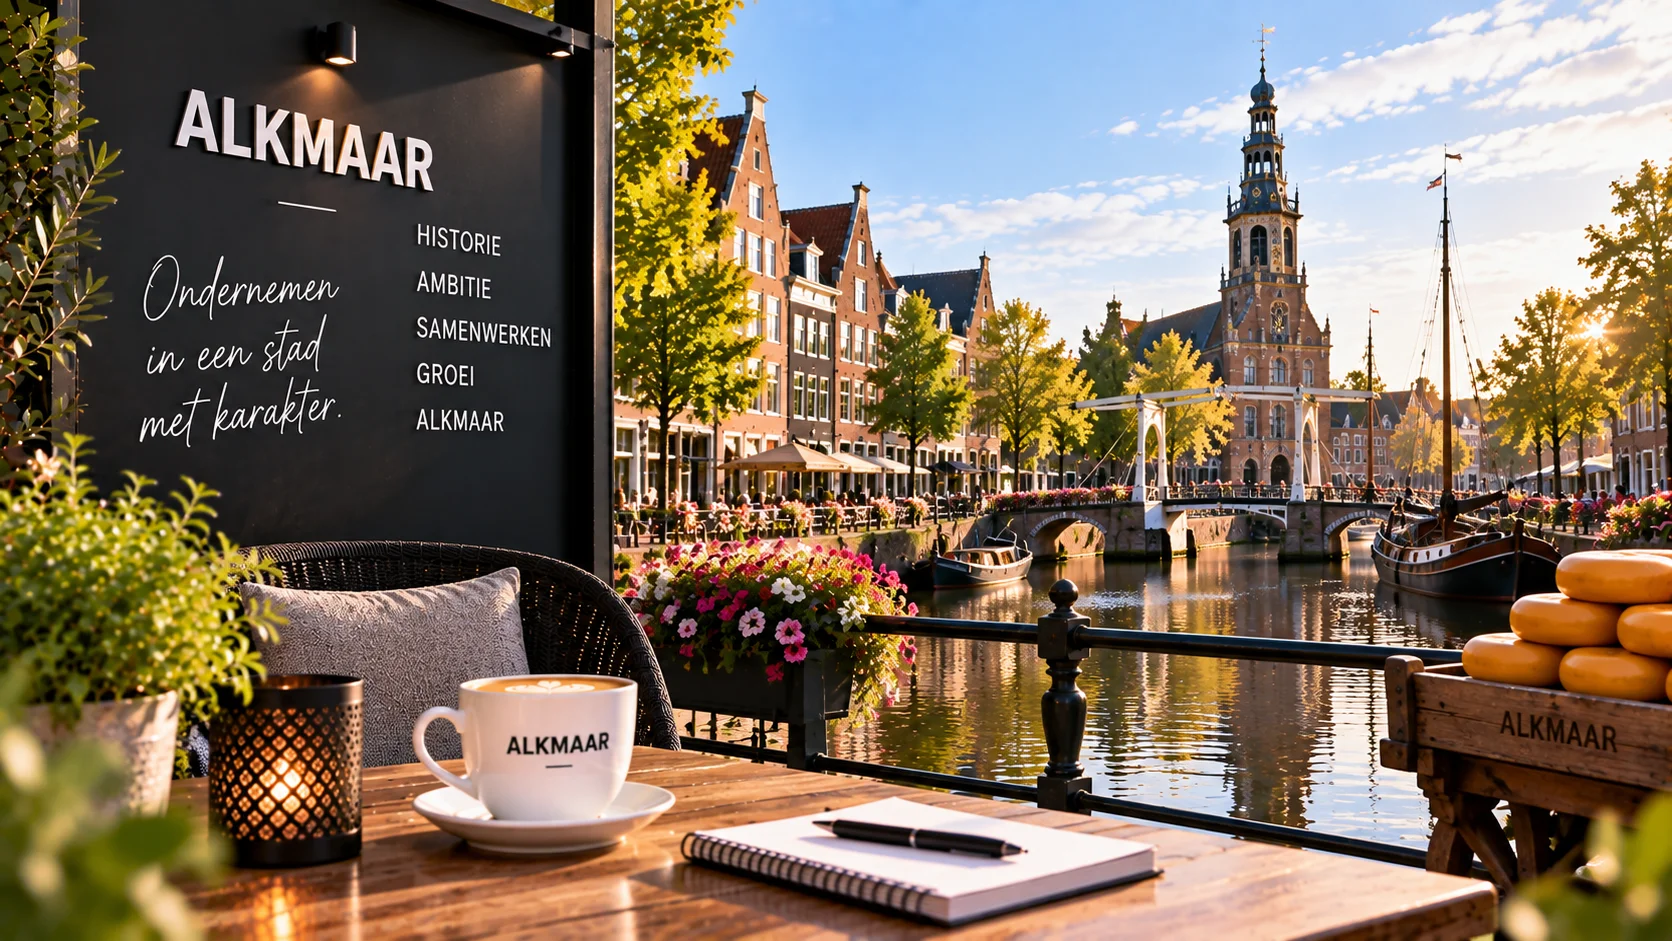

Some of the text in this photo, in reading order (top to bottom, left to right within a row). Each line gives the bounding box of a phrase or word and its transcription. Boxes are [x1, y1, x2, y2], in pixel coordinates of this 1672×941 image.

[175, 89, 434, 191] ALKMAAR
[416, 223, 502, 257] HISTORIE
[142, 254, 340, 321] Ondernemen
[416, 270, 492, 299] AMBITIE
[146, 313, 328, 375] in een stad
[416, 316, 551, 348] SAMENWERKEN
[416, 362, 475, 387] GROEI
[139, 376, 342, 448] met karakter.
[416, 408, 504, 432] ALKMAAR
[506, 732, 610, 755] ALKMAAR
[1500, 710, 1618, 753] ALKMAAR
